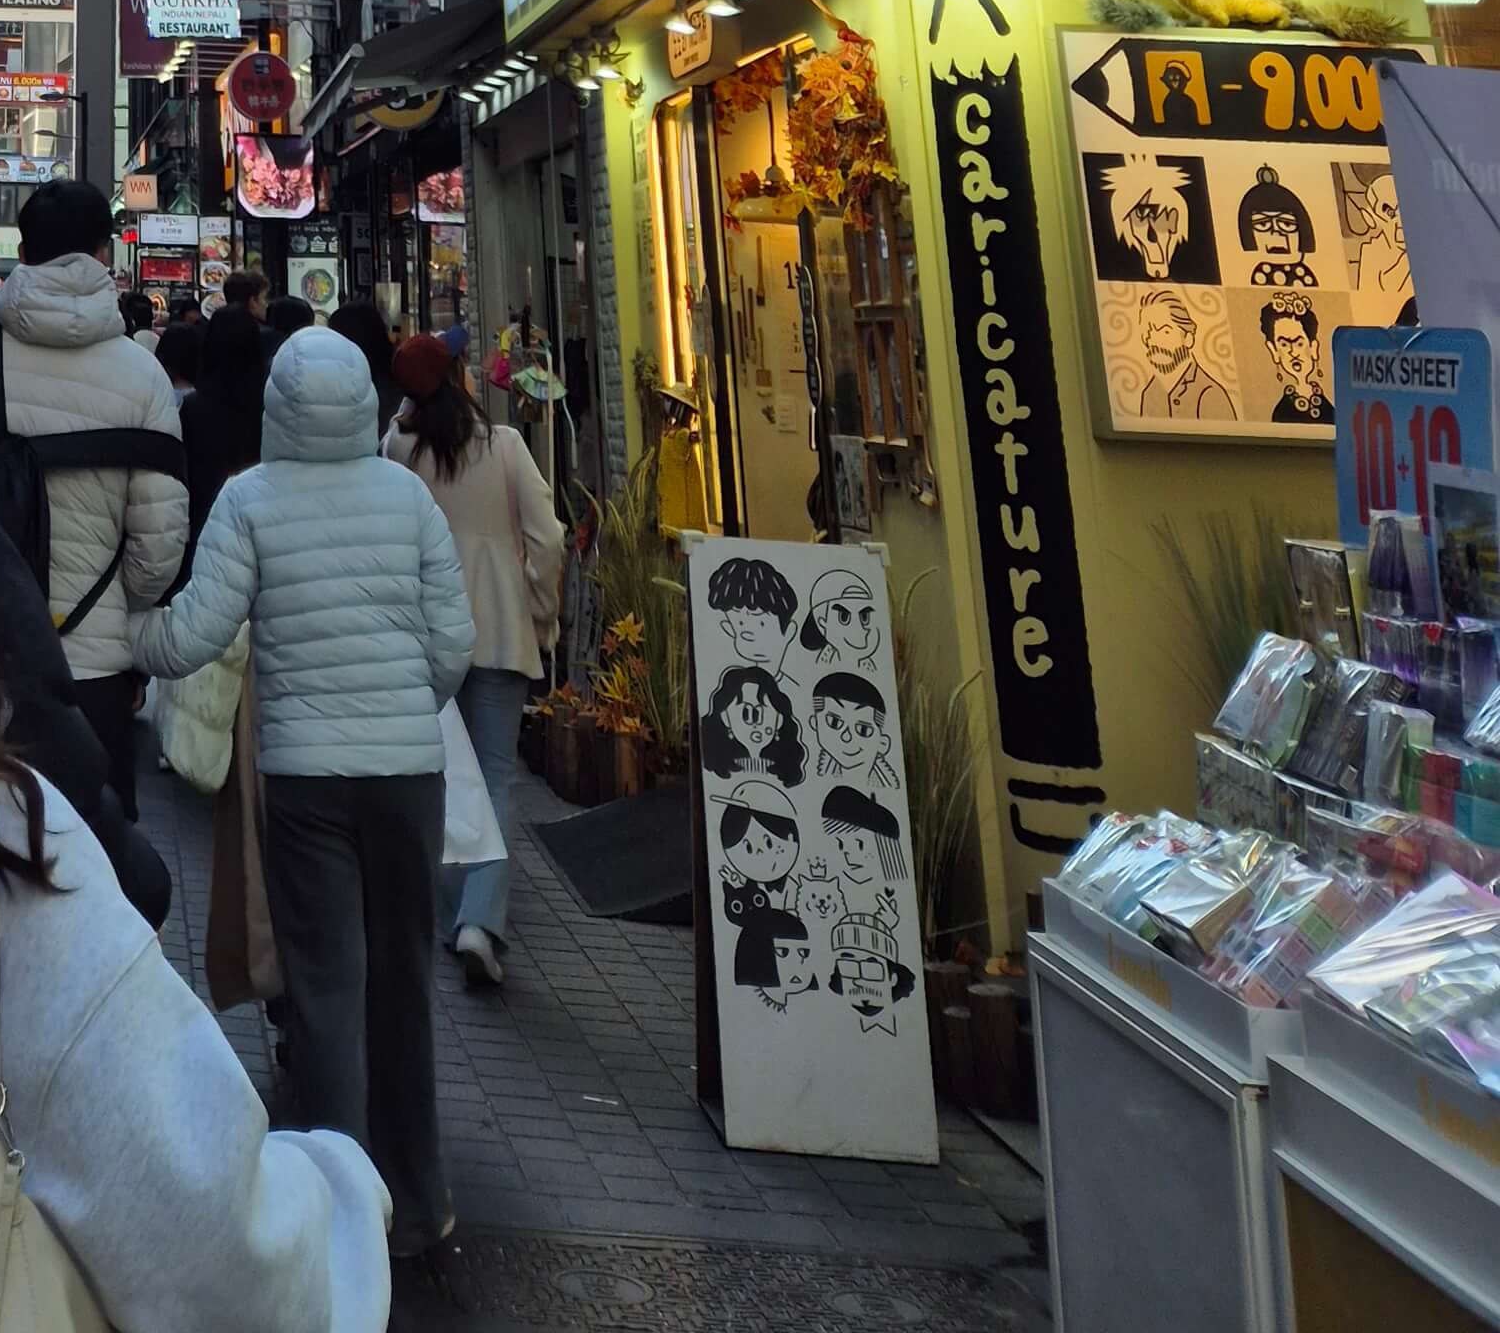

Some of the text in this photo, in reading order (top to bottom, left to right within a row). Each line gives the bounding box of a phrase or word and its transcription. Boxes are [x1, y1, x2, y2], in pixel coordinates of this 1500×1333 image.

[158, 22, 231, 34] RESTAURANT
[956, 90, 1055, 678] caricature
[1352, 354, 1460, 388] MASK SHEET
